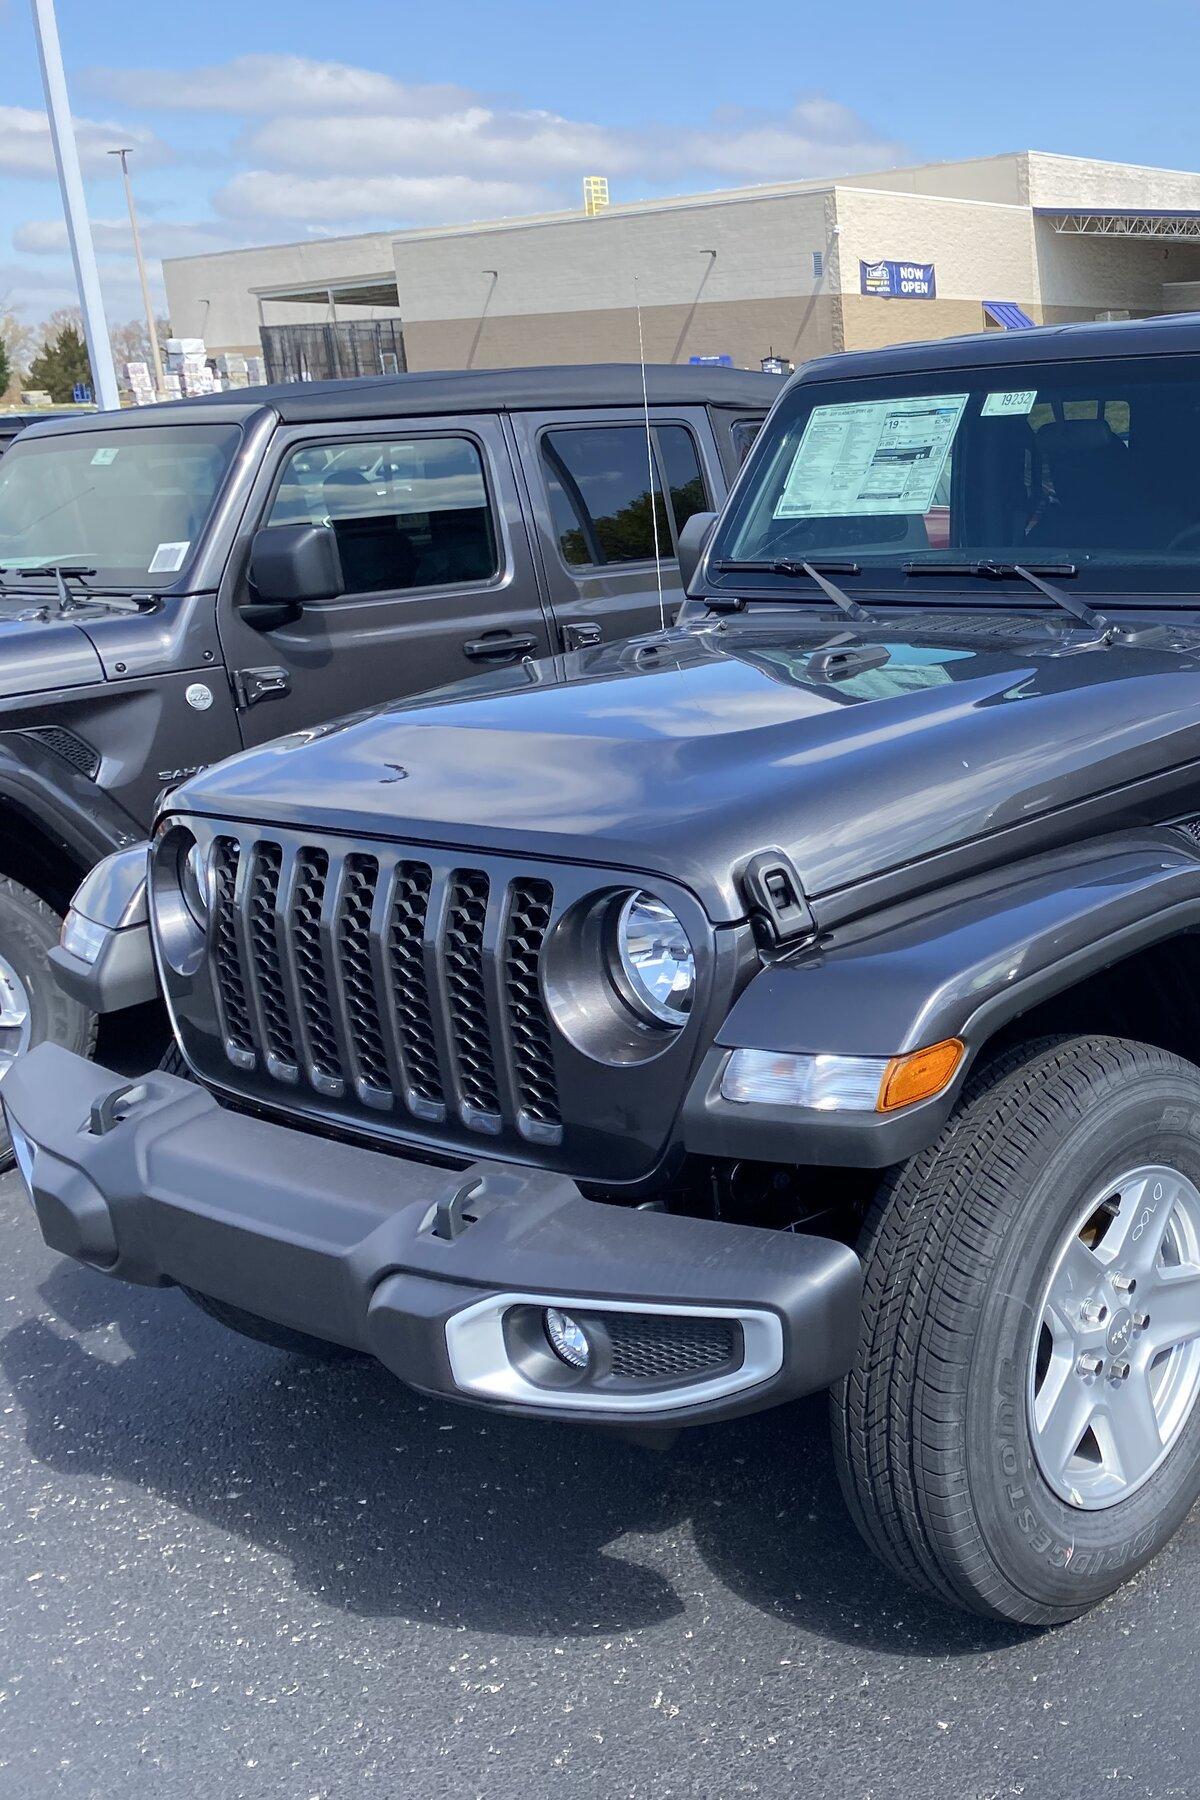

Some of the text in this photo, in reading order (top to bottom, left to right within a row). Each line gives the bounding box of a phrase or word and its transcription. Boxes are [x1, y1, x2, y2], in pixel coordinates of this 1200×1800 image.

[900, 267, 924, 280] NOW
[901, 281, 929, 294] OPEN
[1001, 392, 1032, 406] 19232
[889, 420, 899, 430] 19
